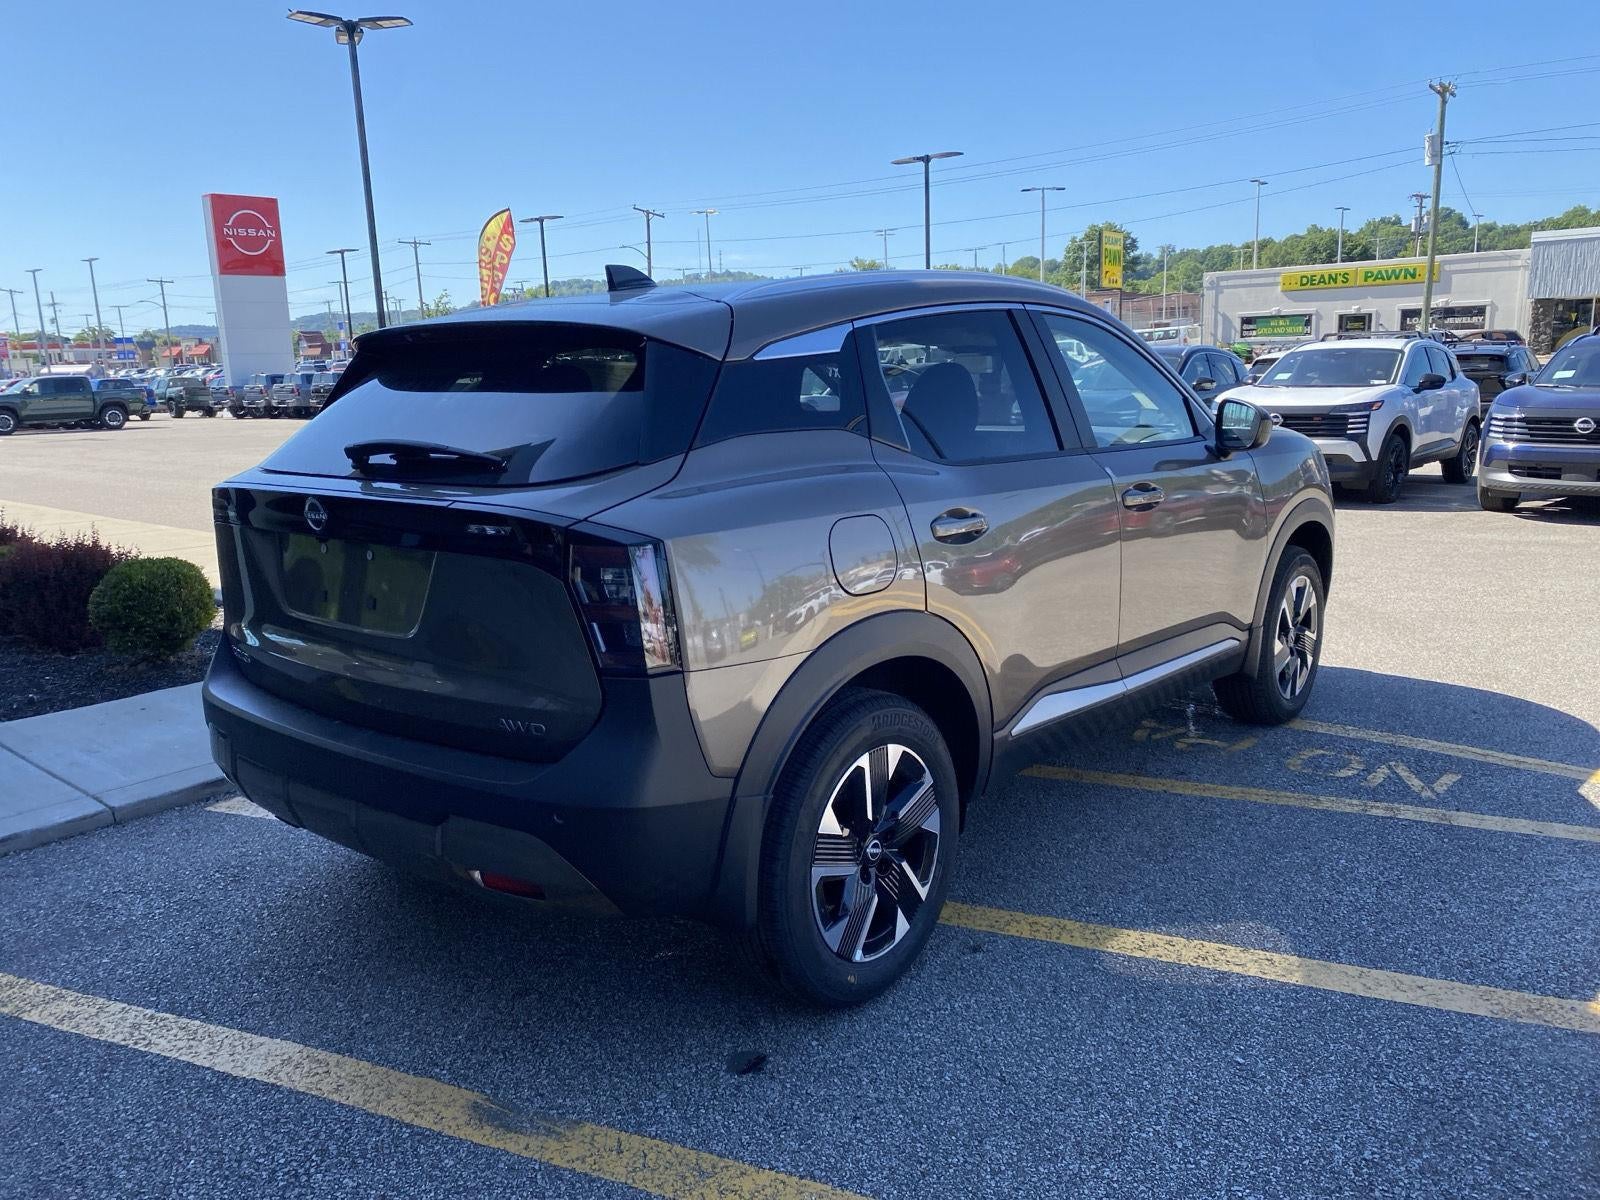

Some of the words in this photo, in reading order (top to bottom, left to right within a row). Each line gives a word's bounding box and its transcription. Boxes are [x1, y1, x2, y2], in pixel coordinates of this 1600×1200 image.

[223, 227, 276, 237] NISSAN
[1104, 248, 1122, 267] PAWN
[1299, 272, 1350, 287] DEAN'S
[1363, 267, 1417, 283] PAWN
[1444, 316, 1484, 324] JEWELRY
[1257, 327, 1273, 335] GOLD
[1273, 326, 1285, 334] AND
